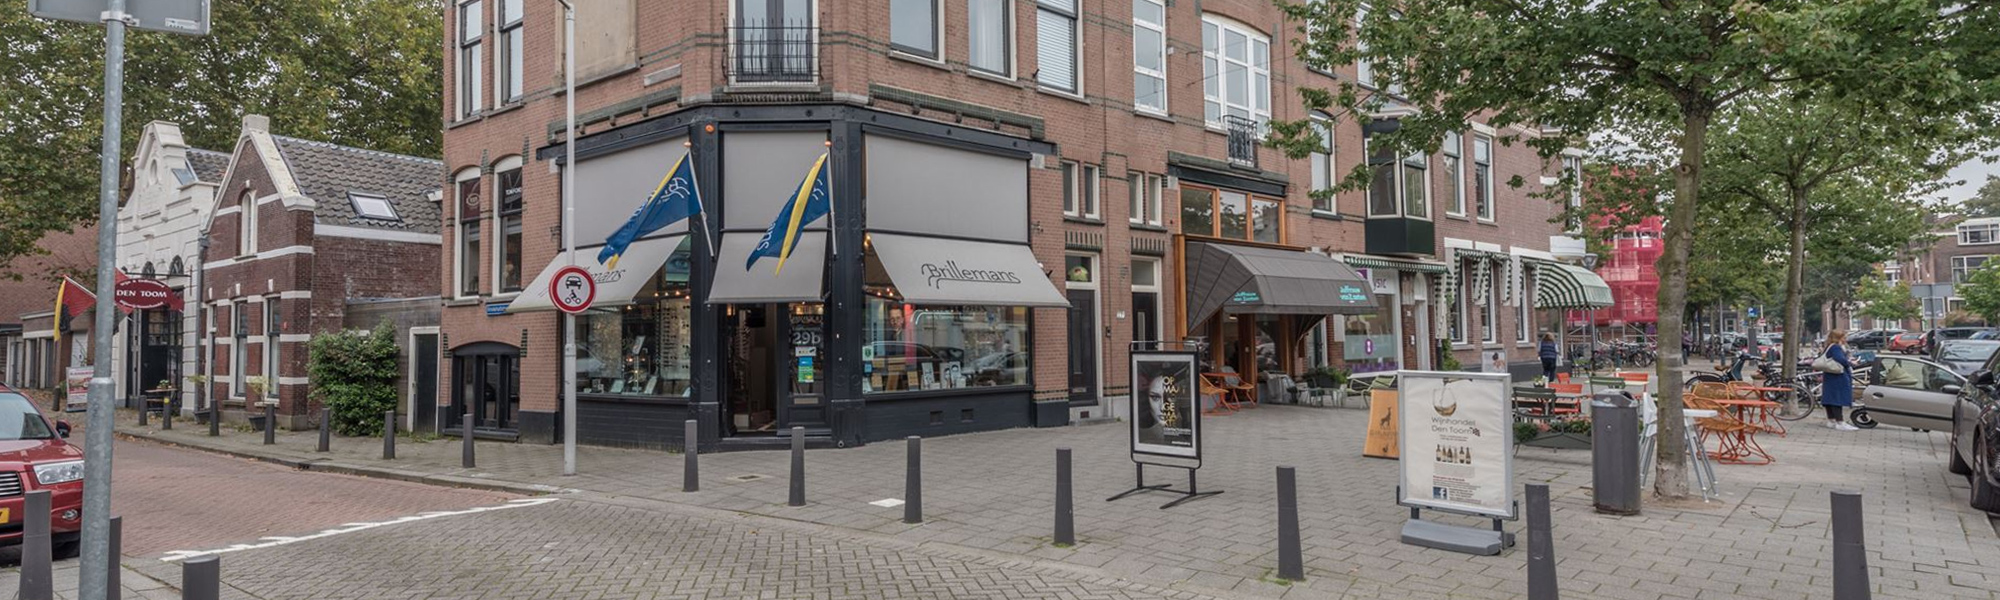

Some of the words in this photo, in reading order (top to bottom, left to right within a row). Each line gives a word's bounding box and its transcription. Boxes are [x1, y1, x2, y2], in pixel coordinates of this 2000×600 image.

[921, 260, 1021, 289] Brillemans
[793, 332, 820, 345] 29b
[1431, 417, 1475, 426] Wijnhandel
[1450, 426, 1471, 434] Toom
